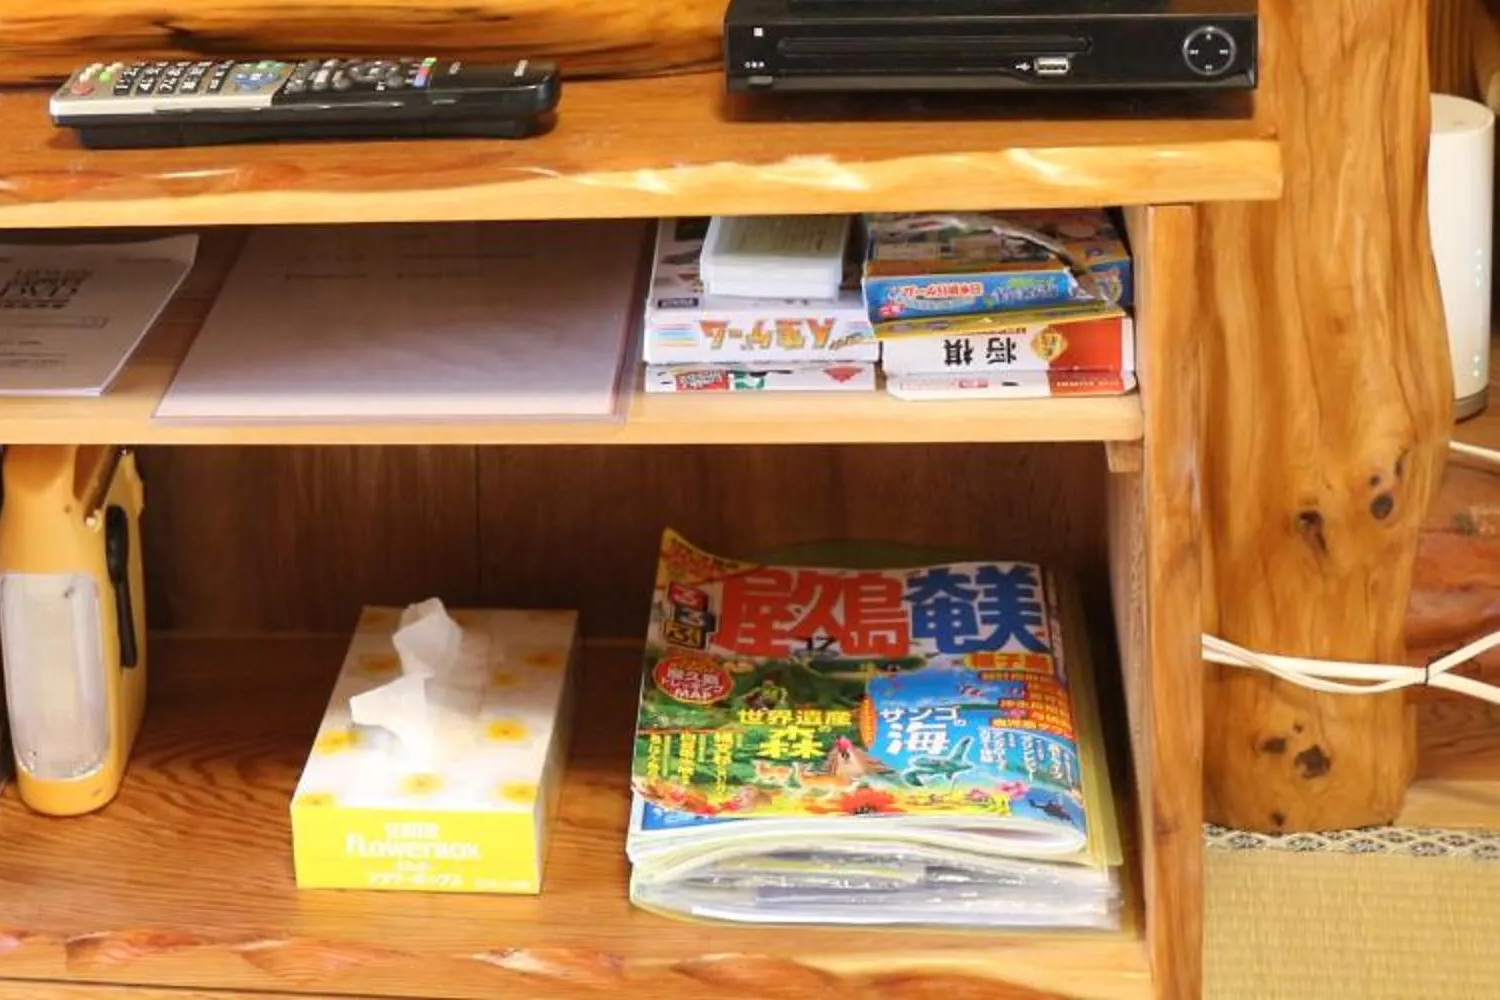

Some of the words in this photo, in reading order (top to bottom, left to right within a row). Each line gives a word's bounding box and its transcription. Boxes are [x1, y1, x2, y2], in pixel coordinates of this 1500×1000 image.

[943, 337, 1017, 367] 将棋
[716, 570, 908, 657] 屋久島
[903, 564, 1051, 655] 奄美
[757, 725, 826, 759] 森
[886, 721, 952, 755] 海
